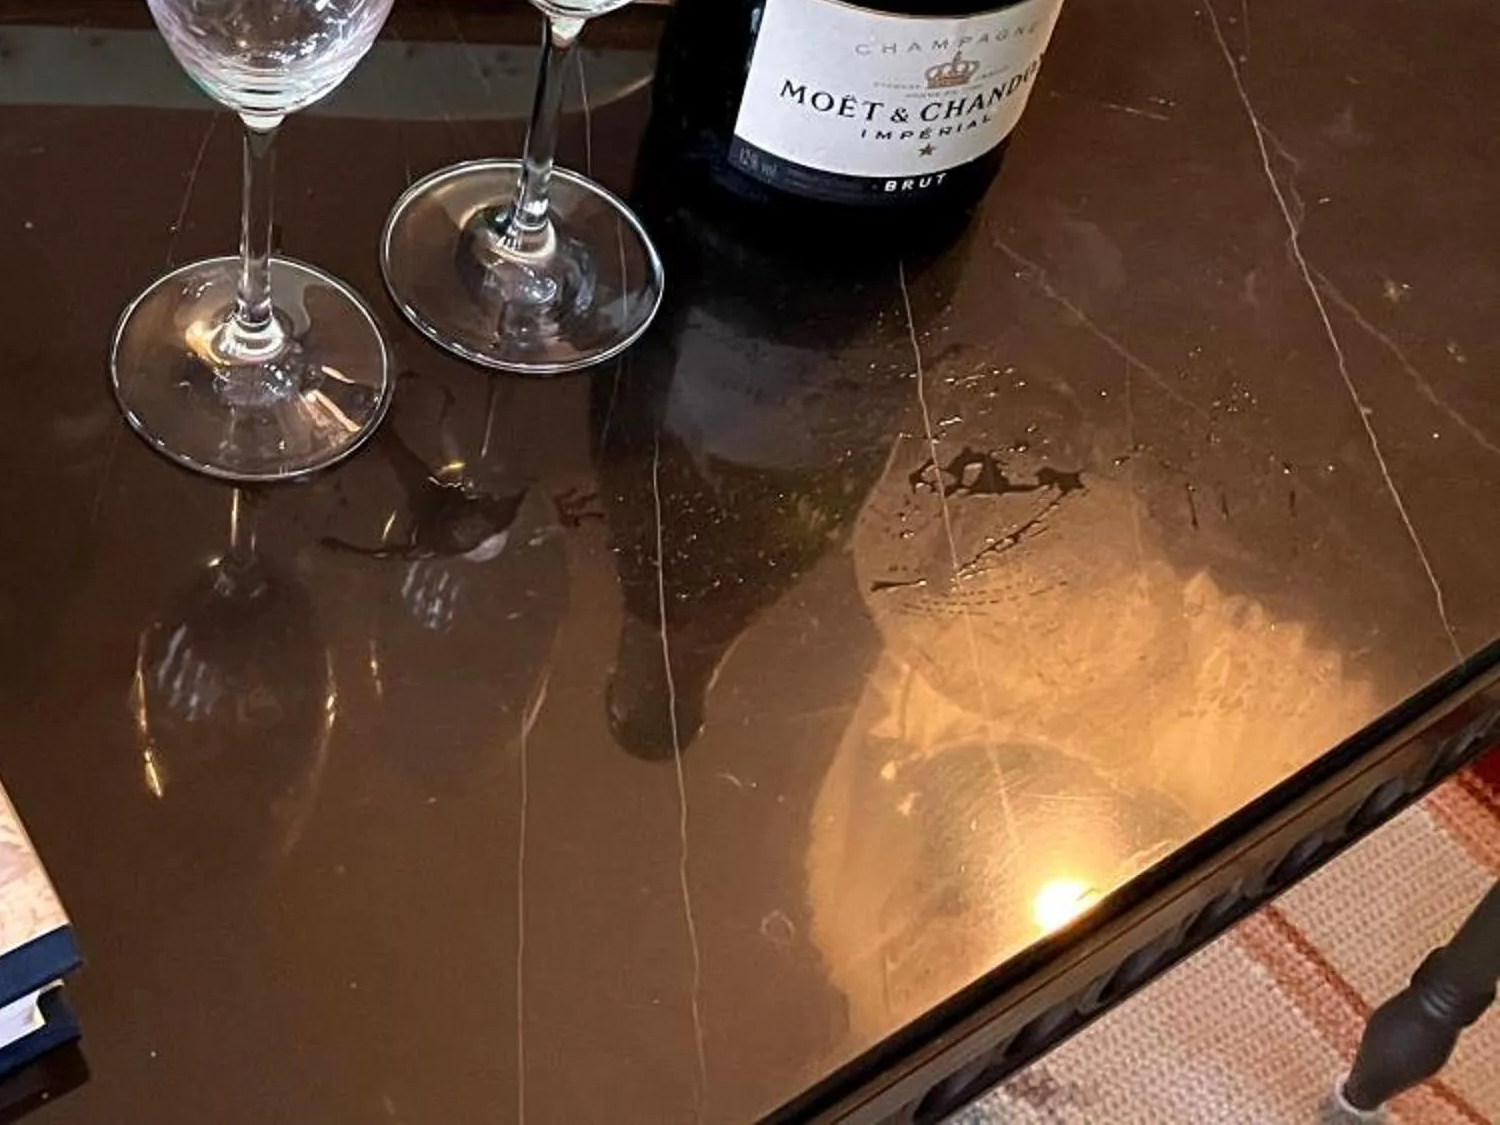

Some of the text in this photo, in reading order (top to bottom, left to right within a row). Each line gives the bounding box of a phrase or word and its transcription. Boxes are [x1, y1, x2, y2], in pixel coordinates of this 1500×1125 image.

[890, 106, 910, 124] &
[861, 114, 992, 141] IMPÉRIAL
[884, 172, 948, 193] BRUT
